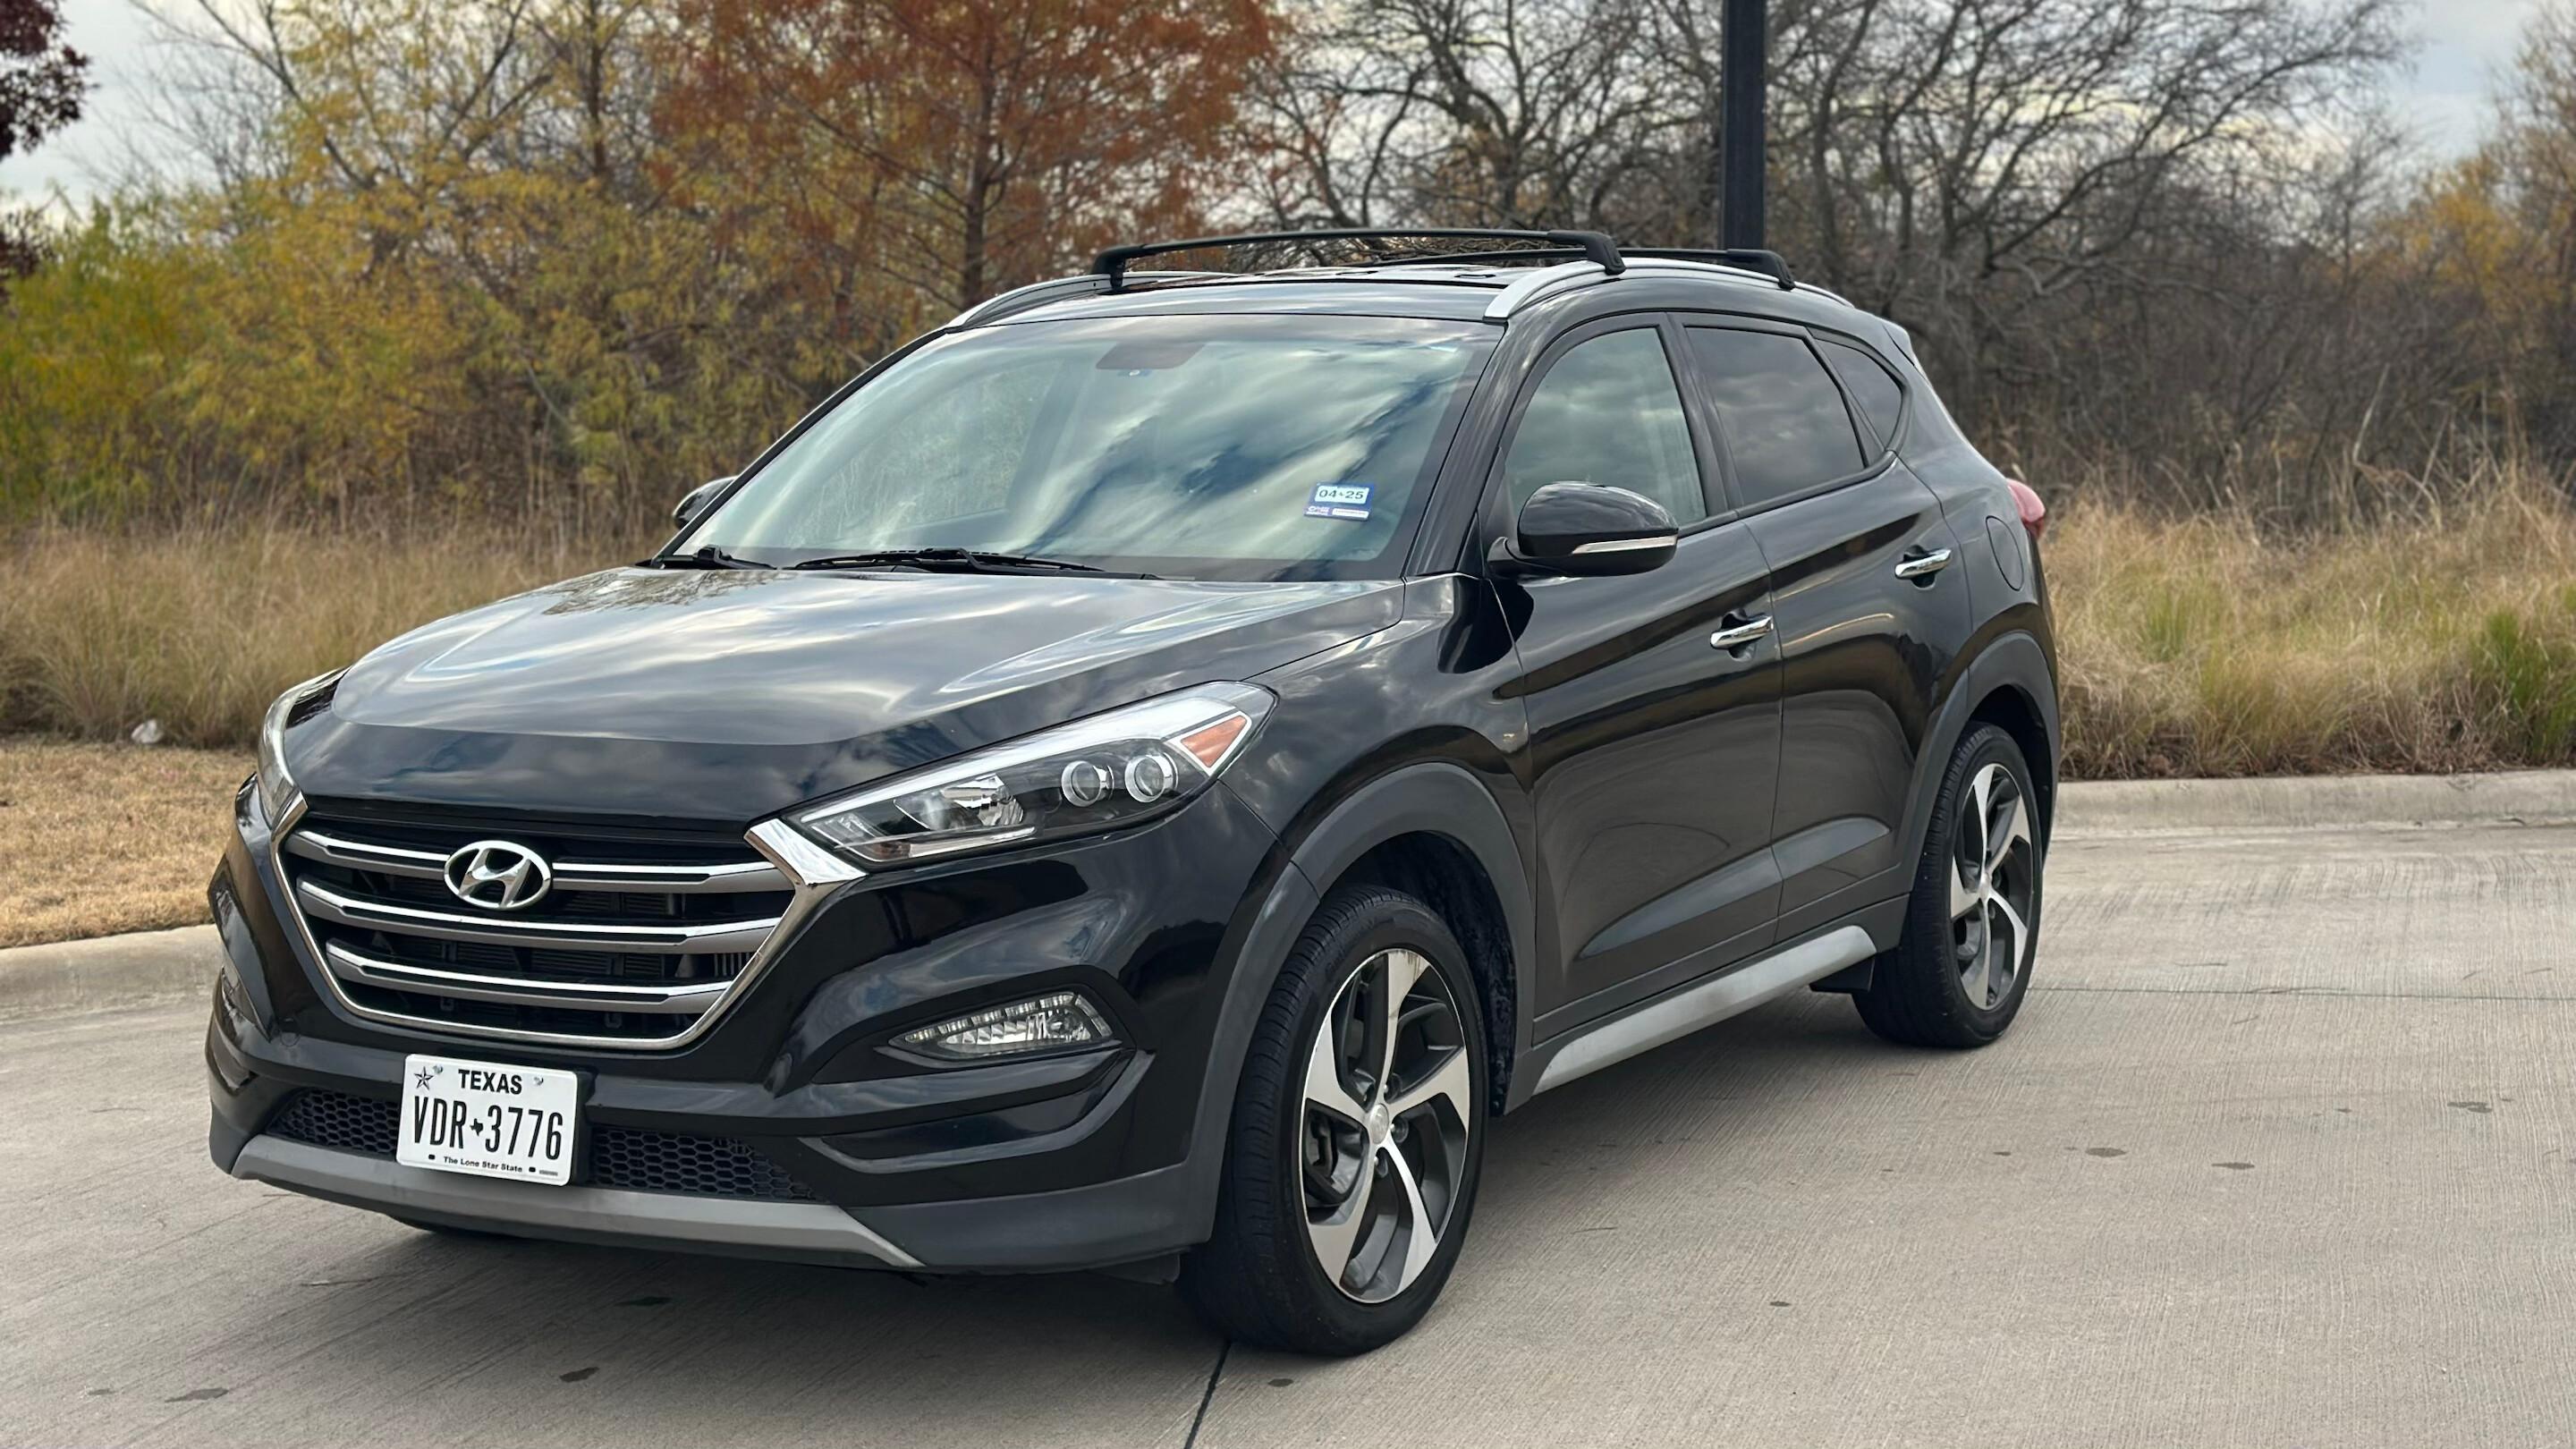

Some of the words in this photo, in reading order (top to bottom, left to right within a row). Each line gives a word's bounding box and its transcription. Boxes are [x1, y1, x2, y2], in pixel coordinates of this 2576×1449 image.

[458, 1068, 522, 1095] TEXAS
[414, 1095, 467, 1149] VDR
[485, 1105, 564, 1161] 3776
[443, 1156, 458, 1165] The
[460, 1158, 479, 1167] Lone
[482, 1161, 499, 1170] Star
[501, 1163, 523, 1173] State
